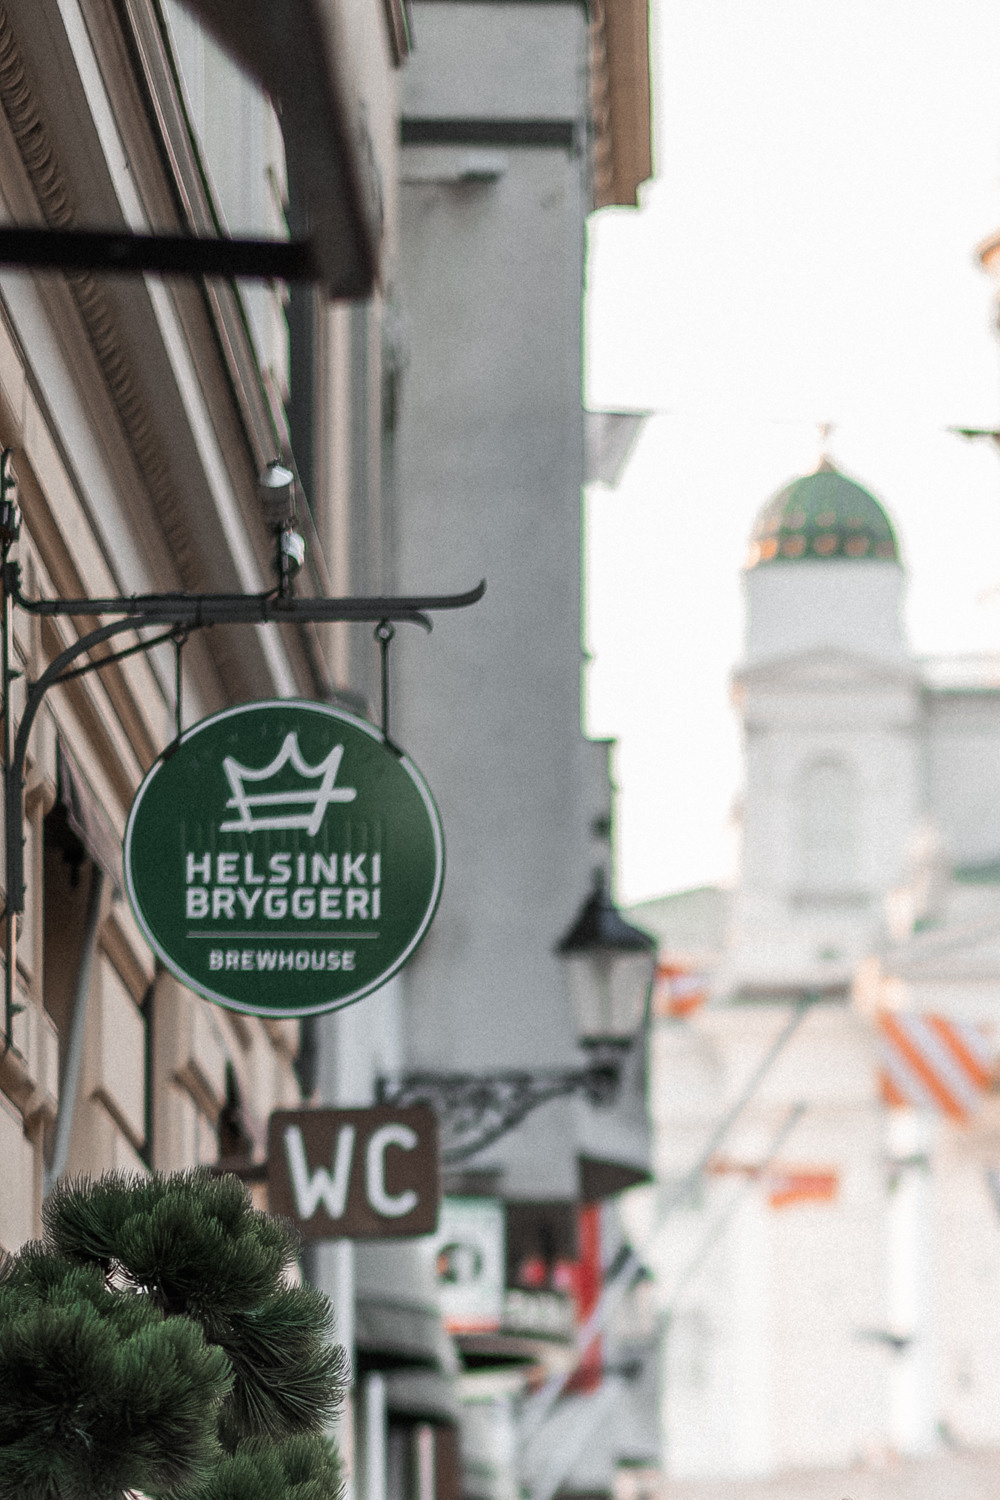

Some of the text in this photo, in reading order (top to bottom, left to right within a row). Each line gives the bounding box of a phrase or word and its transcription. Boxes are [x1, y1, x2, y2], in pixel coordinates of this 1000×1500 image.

[185, 852, 381, 885] HELSINKI
[185, 887, 381, 920] BRYGGERI
[210, 949, 356, 971] BREWHOUSE
[285, 1123, 418, 1220] WC
